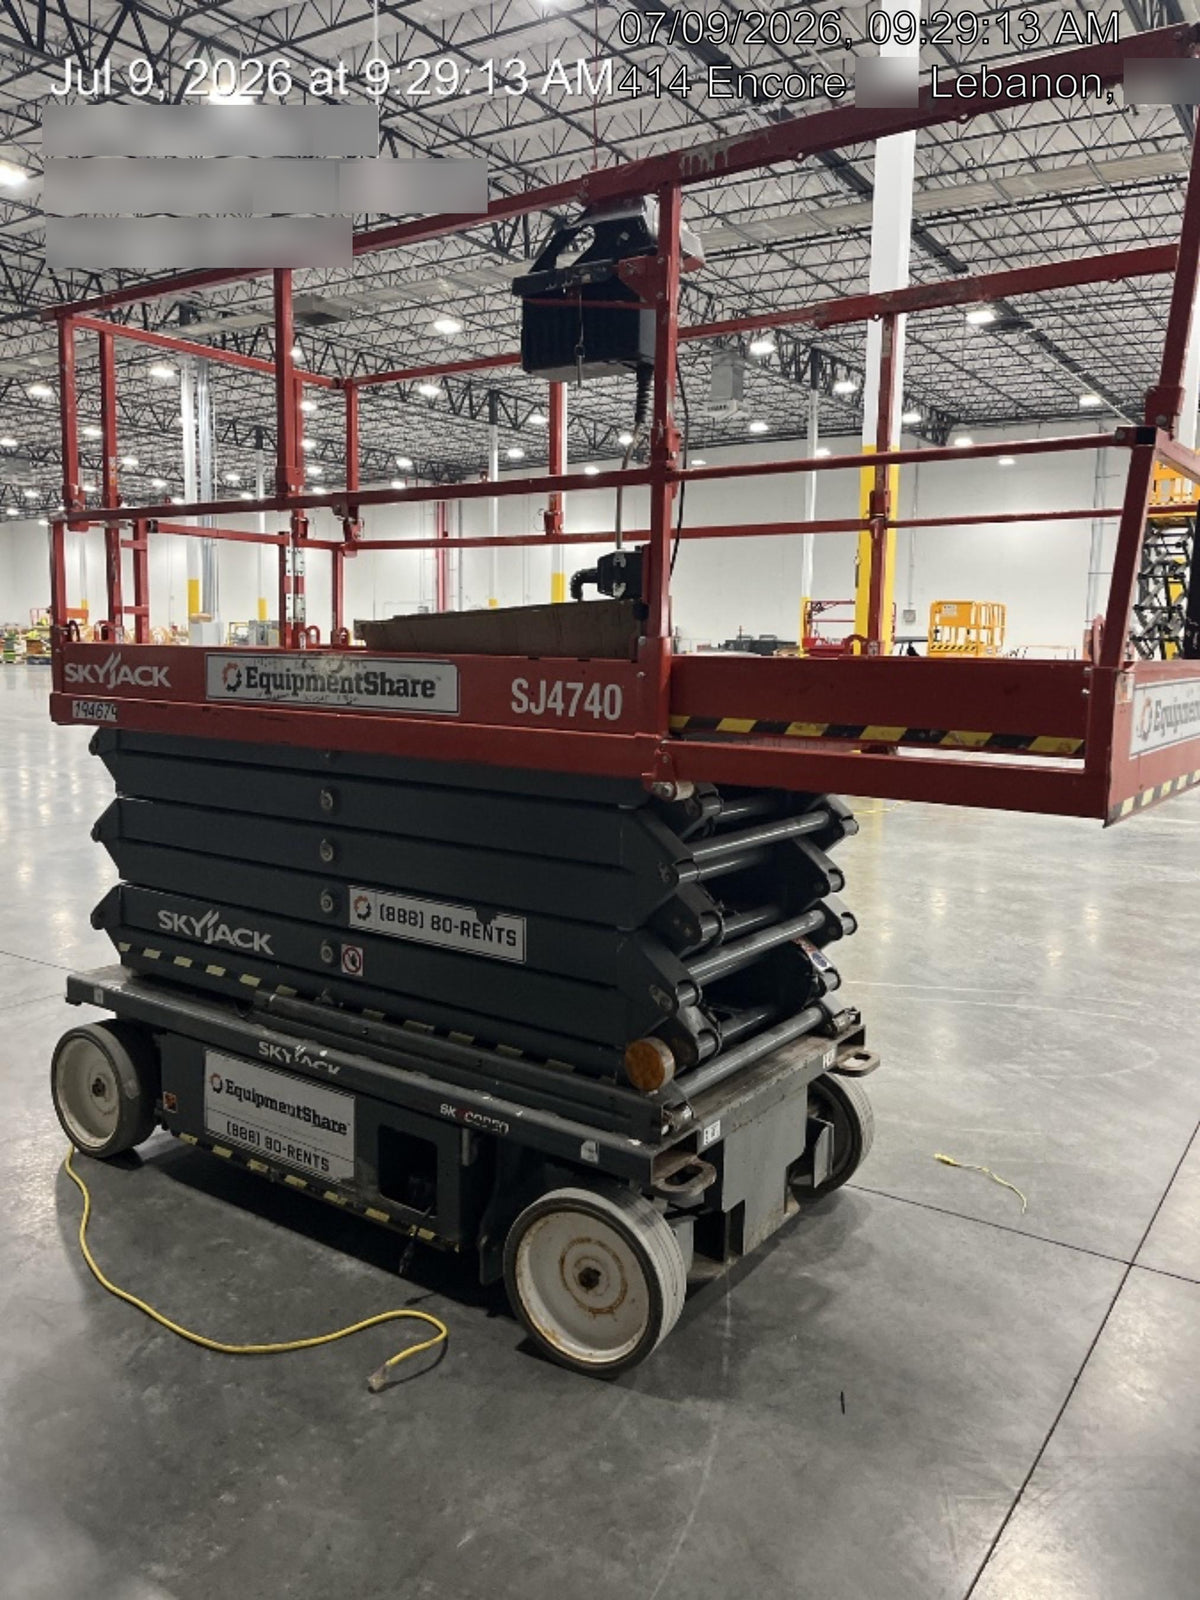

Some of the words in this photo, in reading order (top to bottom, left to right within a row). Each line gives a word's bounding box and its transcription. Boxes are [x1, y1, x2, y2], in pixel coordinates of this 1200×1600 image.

[64, 652, 171, 690] SKYJACK
[245, 666, 436, 698] EquipmentShare
[511, 677, 623, 721] SJ4740
[156, 909, 275, 956] SKYJACK
[379, 903, 424, 929] (888)
[431, 915, 517, 947] 80-RENTS
[225, 1079, 347, 1136] EquipmentShare
[227, 1121, 260, 1147] (888)
[265, 1136, 330, 1172] 80-RENTS
